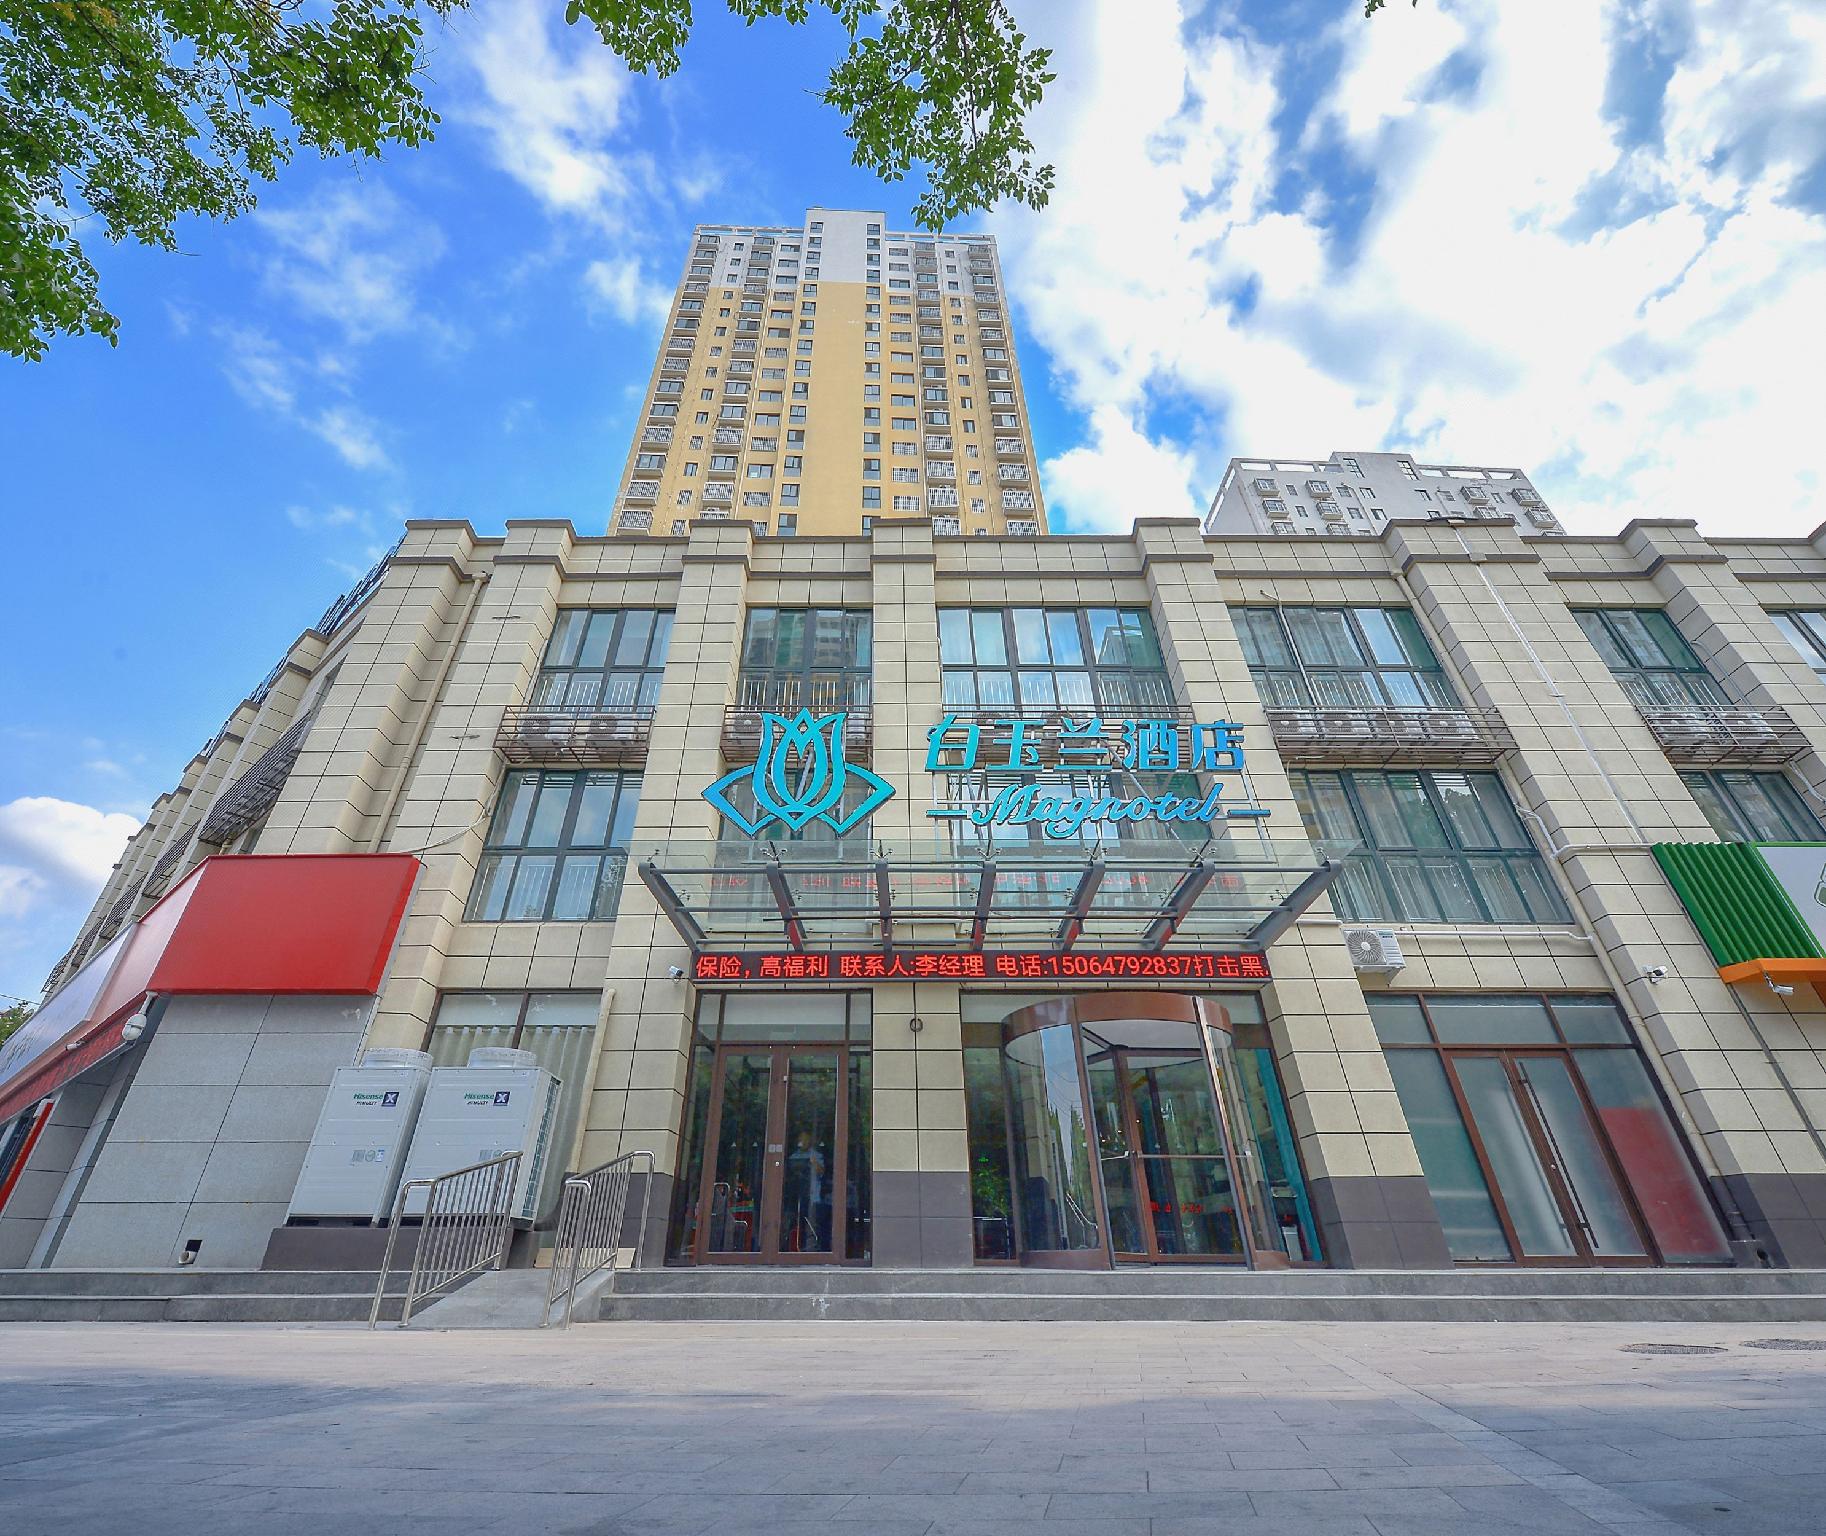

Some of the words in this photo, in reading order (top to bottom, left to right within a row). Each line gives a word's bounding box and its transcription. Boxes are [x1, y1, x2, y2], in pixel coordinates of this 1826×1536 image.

[925, 714, 1245, 773] 白玉兰酒店
[971, 783, 1225, 839] Magnotel
[996, 954, 1269, 978] 电话:15064792837打击黑
